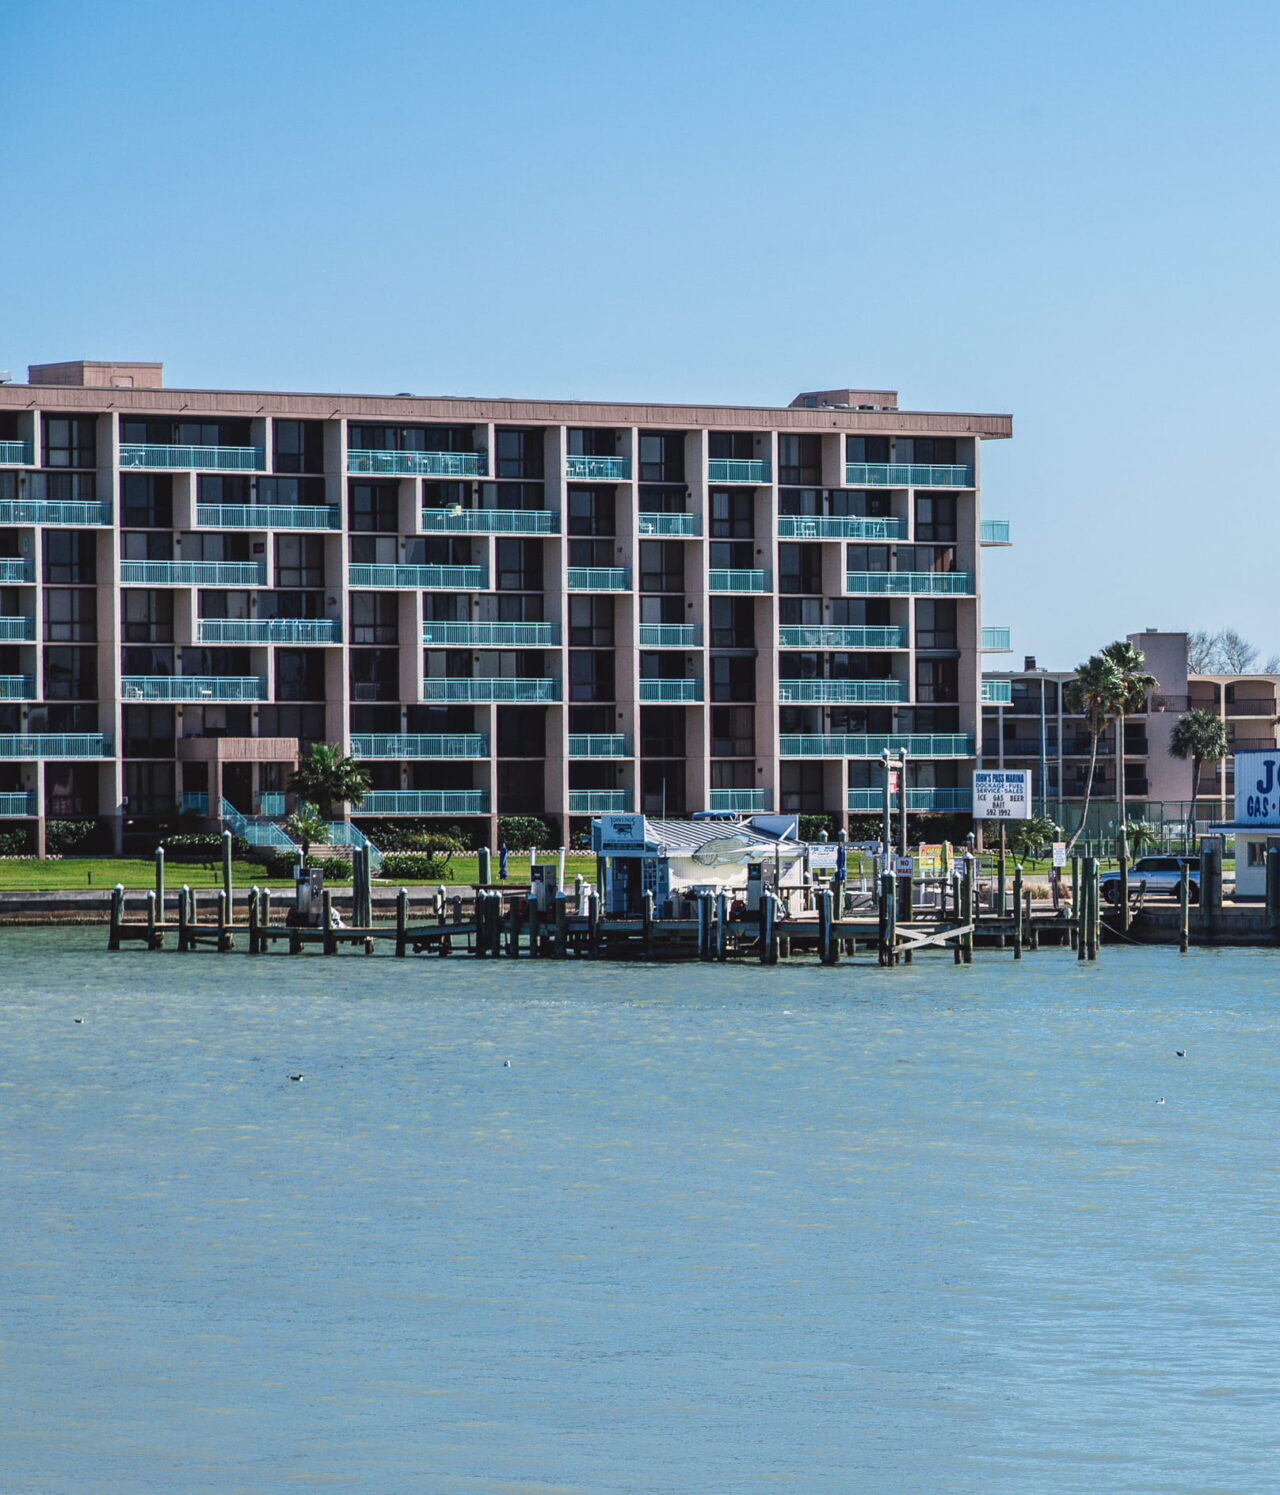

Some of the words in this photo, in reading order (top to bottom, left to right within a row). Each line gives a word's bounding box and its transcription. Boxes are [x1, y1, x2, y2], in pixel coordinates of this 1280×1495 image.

[992, 773, 1005, 783] PASS
[1006, 773, 1025, 784] MARINA
[992, 801, 1006, 809] BAIT
[1247, 795, 1269, 817] GAS
[986, 808, 997, 816] 592
[998, 809, 1011, 817] 1992
